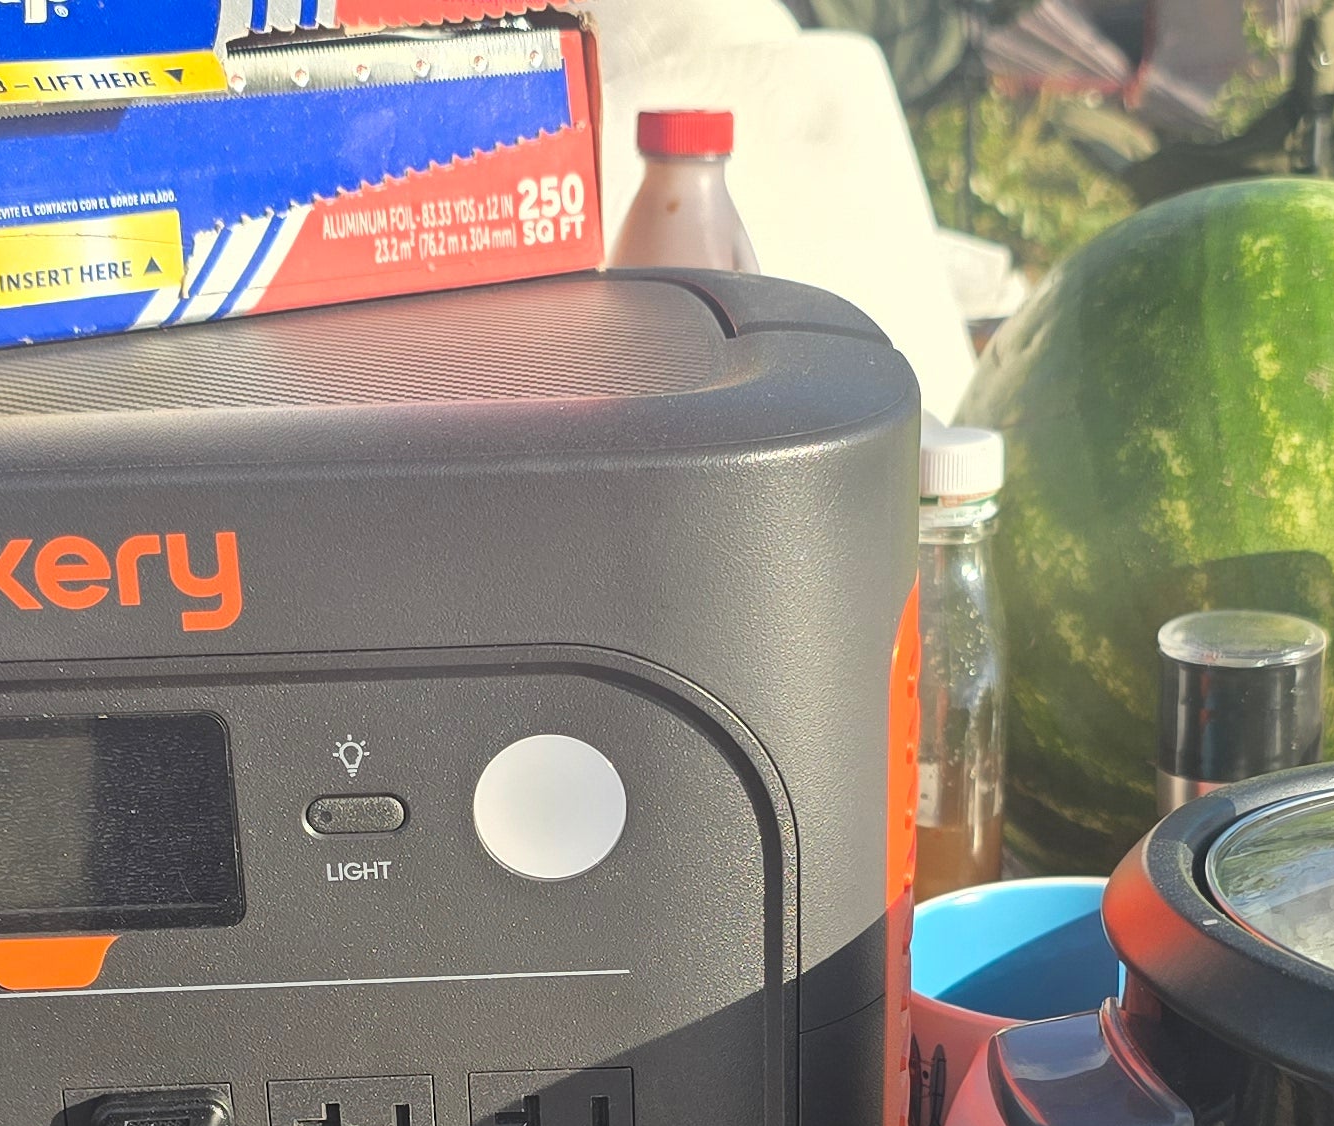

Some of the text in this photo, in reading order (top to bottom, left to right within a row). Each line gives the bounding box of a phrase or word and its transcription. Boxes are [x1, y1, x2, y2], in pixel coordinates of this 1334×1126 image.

[33, 74, 84, 92] LIFT
[90, 70, 157, 90] HERE
[22, 202, 33, 217] EL
[34, 199, 79, 217] CONTACTO
[80, 197, 98, 212] CON
[98, 196, 110, 210] EL
[110, 191, 139, 209] BORDE
[517, 173, 585, 221] 250
[322, 208, 387, 240] ALUMINUM
[390, 206, 417, 231] FOIL
[421, 201, 451, 228] 83.33
[454, 199, 475, 225] YDS
[486, 195, 499, 221] 12
[500, 194, 514, 218] IN
[523, 214, 585, 246] SQ FT
[375, 237, 399, 263] 23.2
[448, 232, 459, 254] m
[469, 226, 491, 252] 304
[492, 222, 517, 248] mm)
[0, 266, 74, 293] INSERT
[80, 260, 133, 284] HERE
[326, 860, 392, 882] LIGHT
